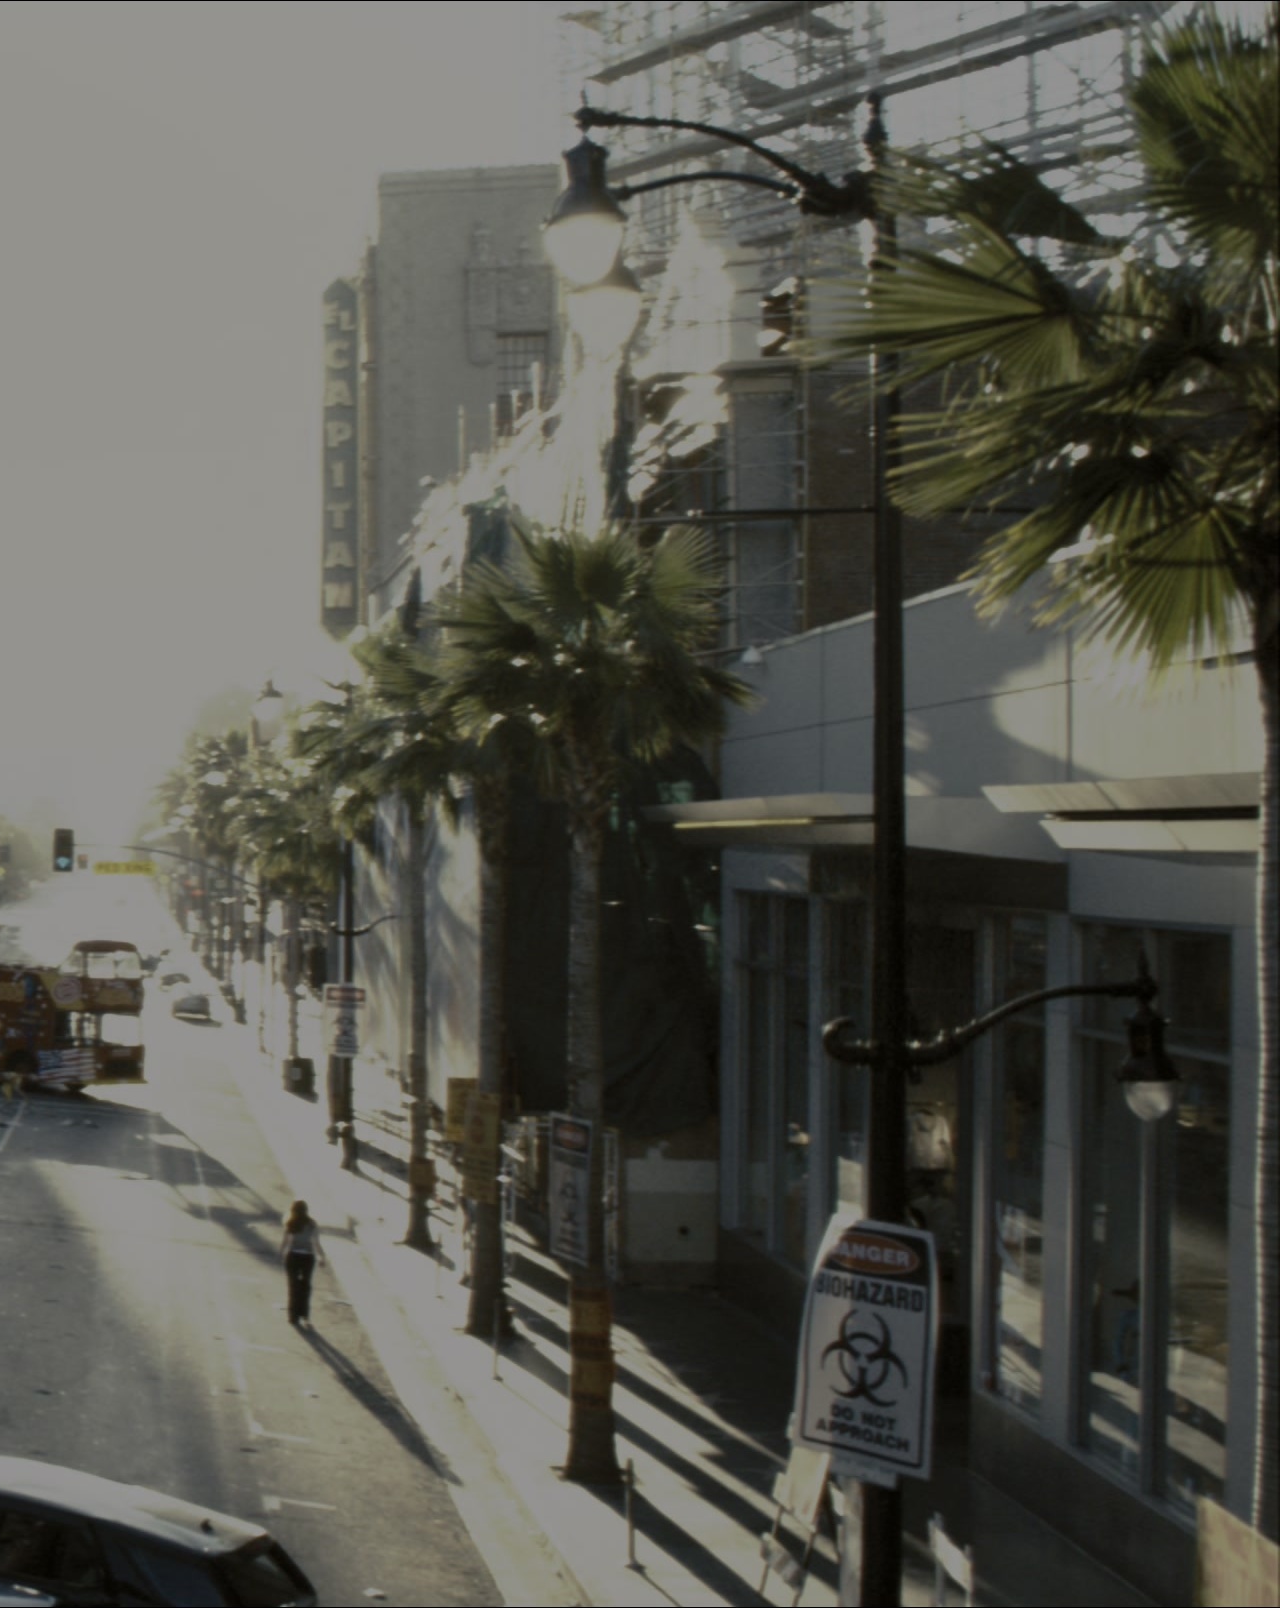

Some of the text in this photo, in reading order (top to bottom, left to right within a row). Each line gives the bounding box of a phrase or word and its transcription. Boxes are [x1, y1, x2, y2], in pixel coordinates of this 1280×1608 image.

[814, 1272, 924, 1312] BIOHAZARD
[831, 1402, 897, 1431] DO NOT
[816, 1418, 910, 1453] APPROACH
